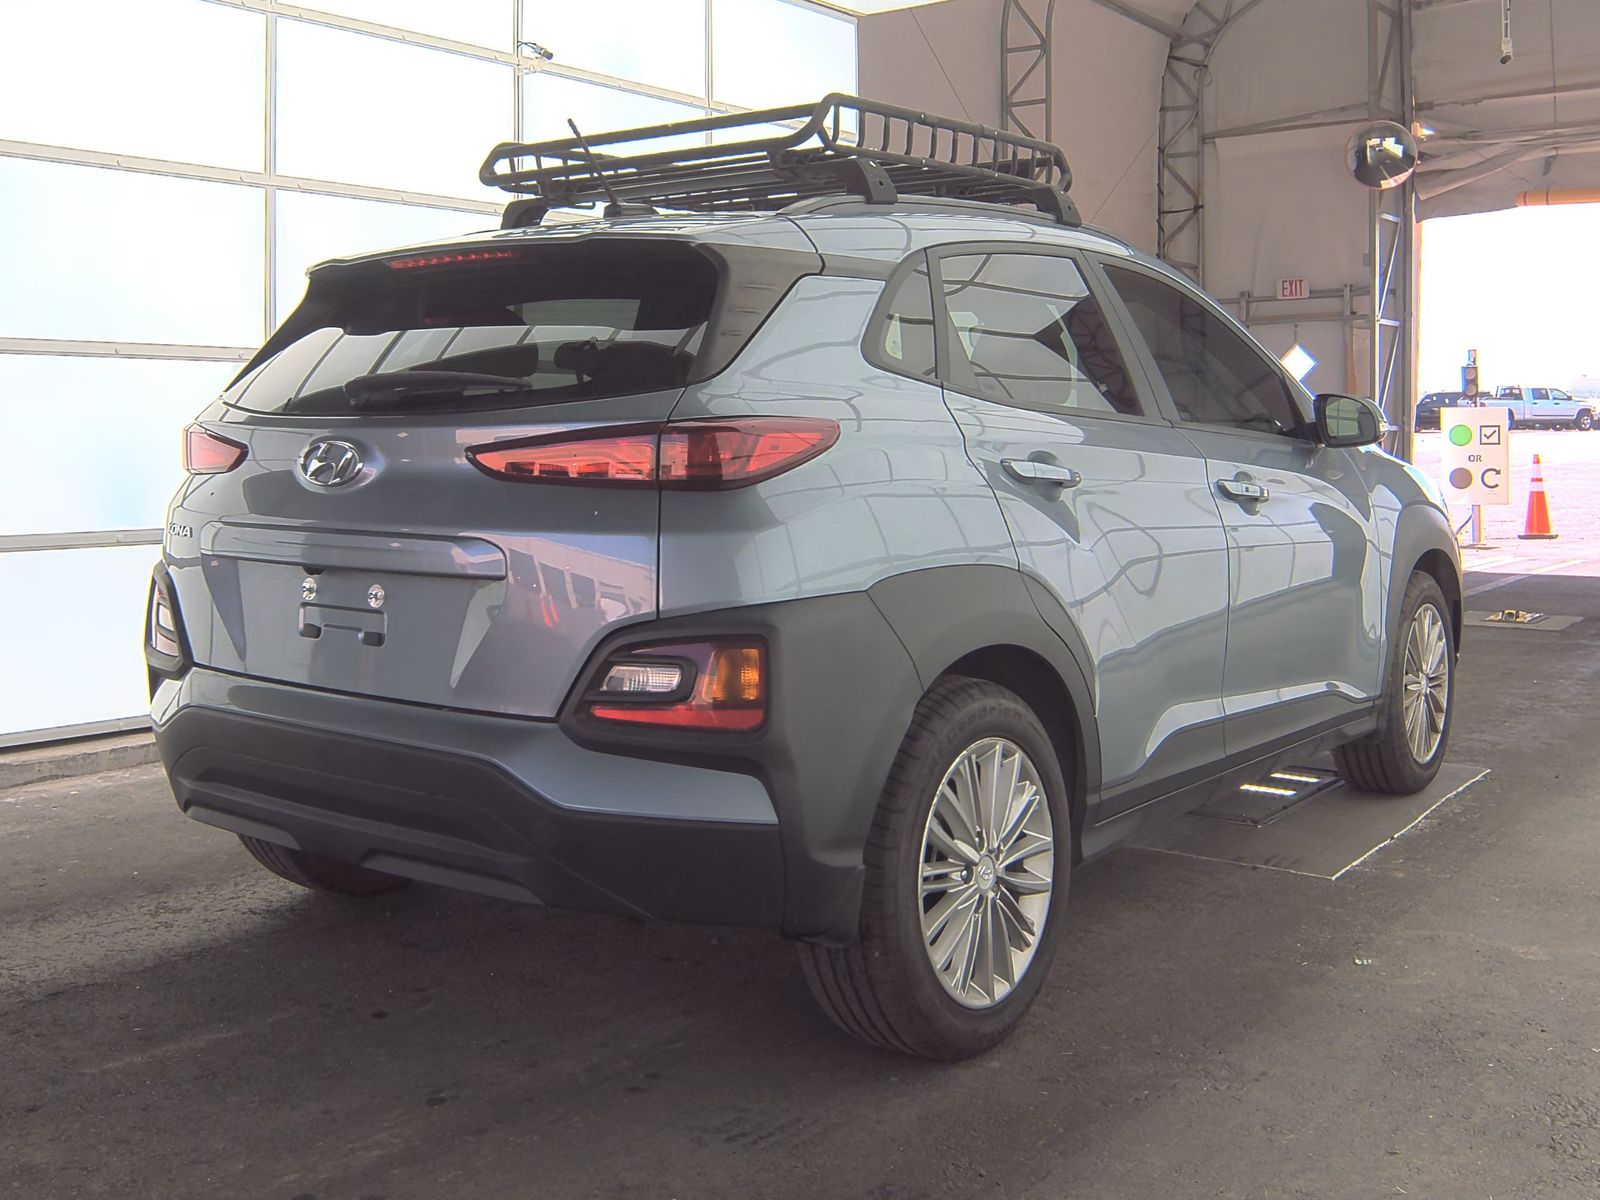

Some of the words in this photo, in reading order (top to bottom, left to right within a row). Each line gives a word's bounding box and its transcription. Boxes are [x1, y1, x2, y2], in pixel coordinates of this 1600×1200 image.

[1281, 279, 1304, 297] EXIT
[1468, 454, 1482, 463] OR
[169, 522, 193, 538] ONA
